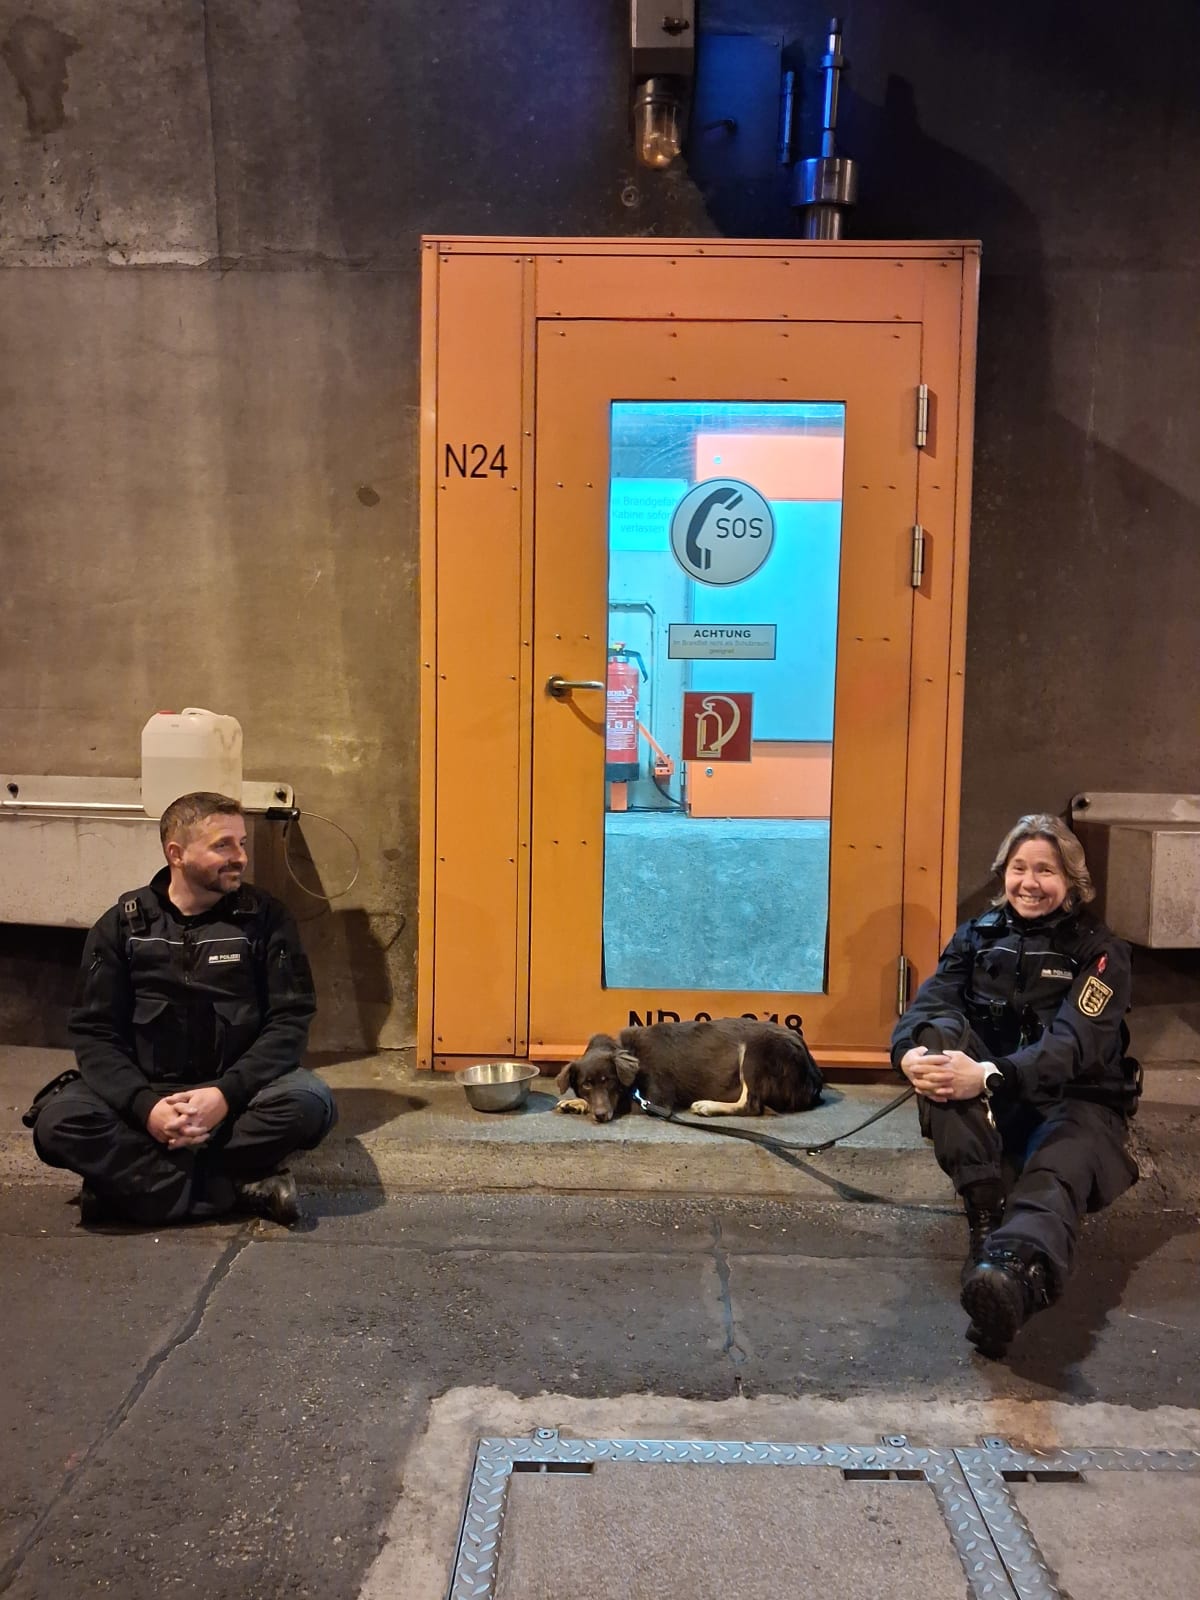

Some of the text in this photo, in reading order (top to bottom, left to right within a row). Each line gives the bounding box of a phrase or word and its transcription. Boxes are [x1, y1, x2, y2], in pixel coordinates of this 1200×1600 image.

[445, 443, 508, 478] N24
[647, 509, 672, 519] sofor
[716, 517, 763, 539] SOS
[693, 629, 752, 638] ACHTUNG
